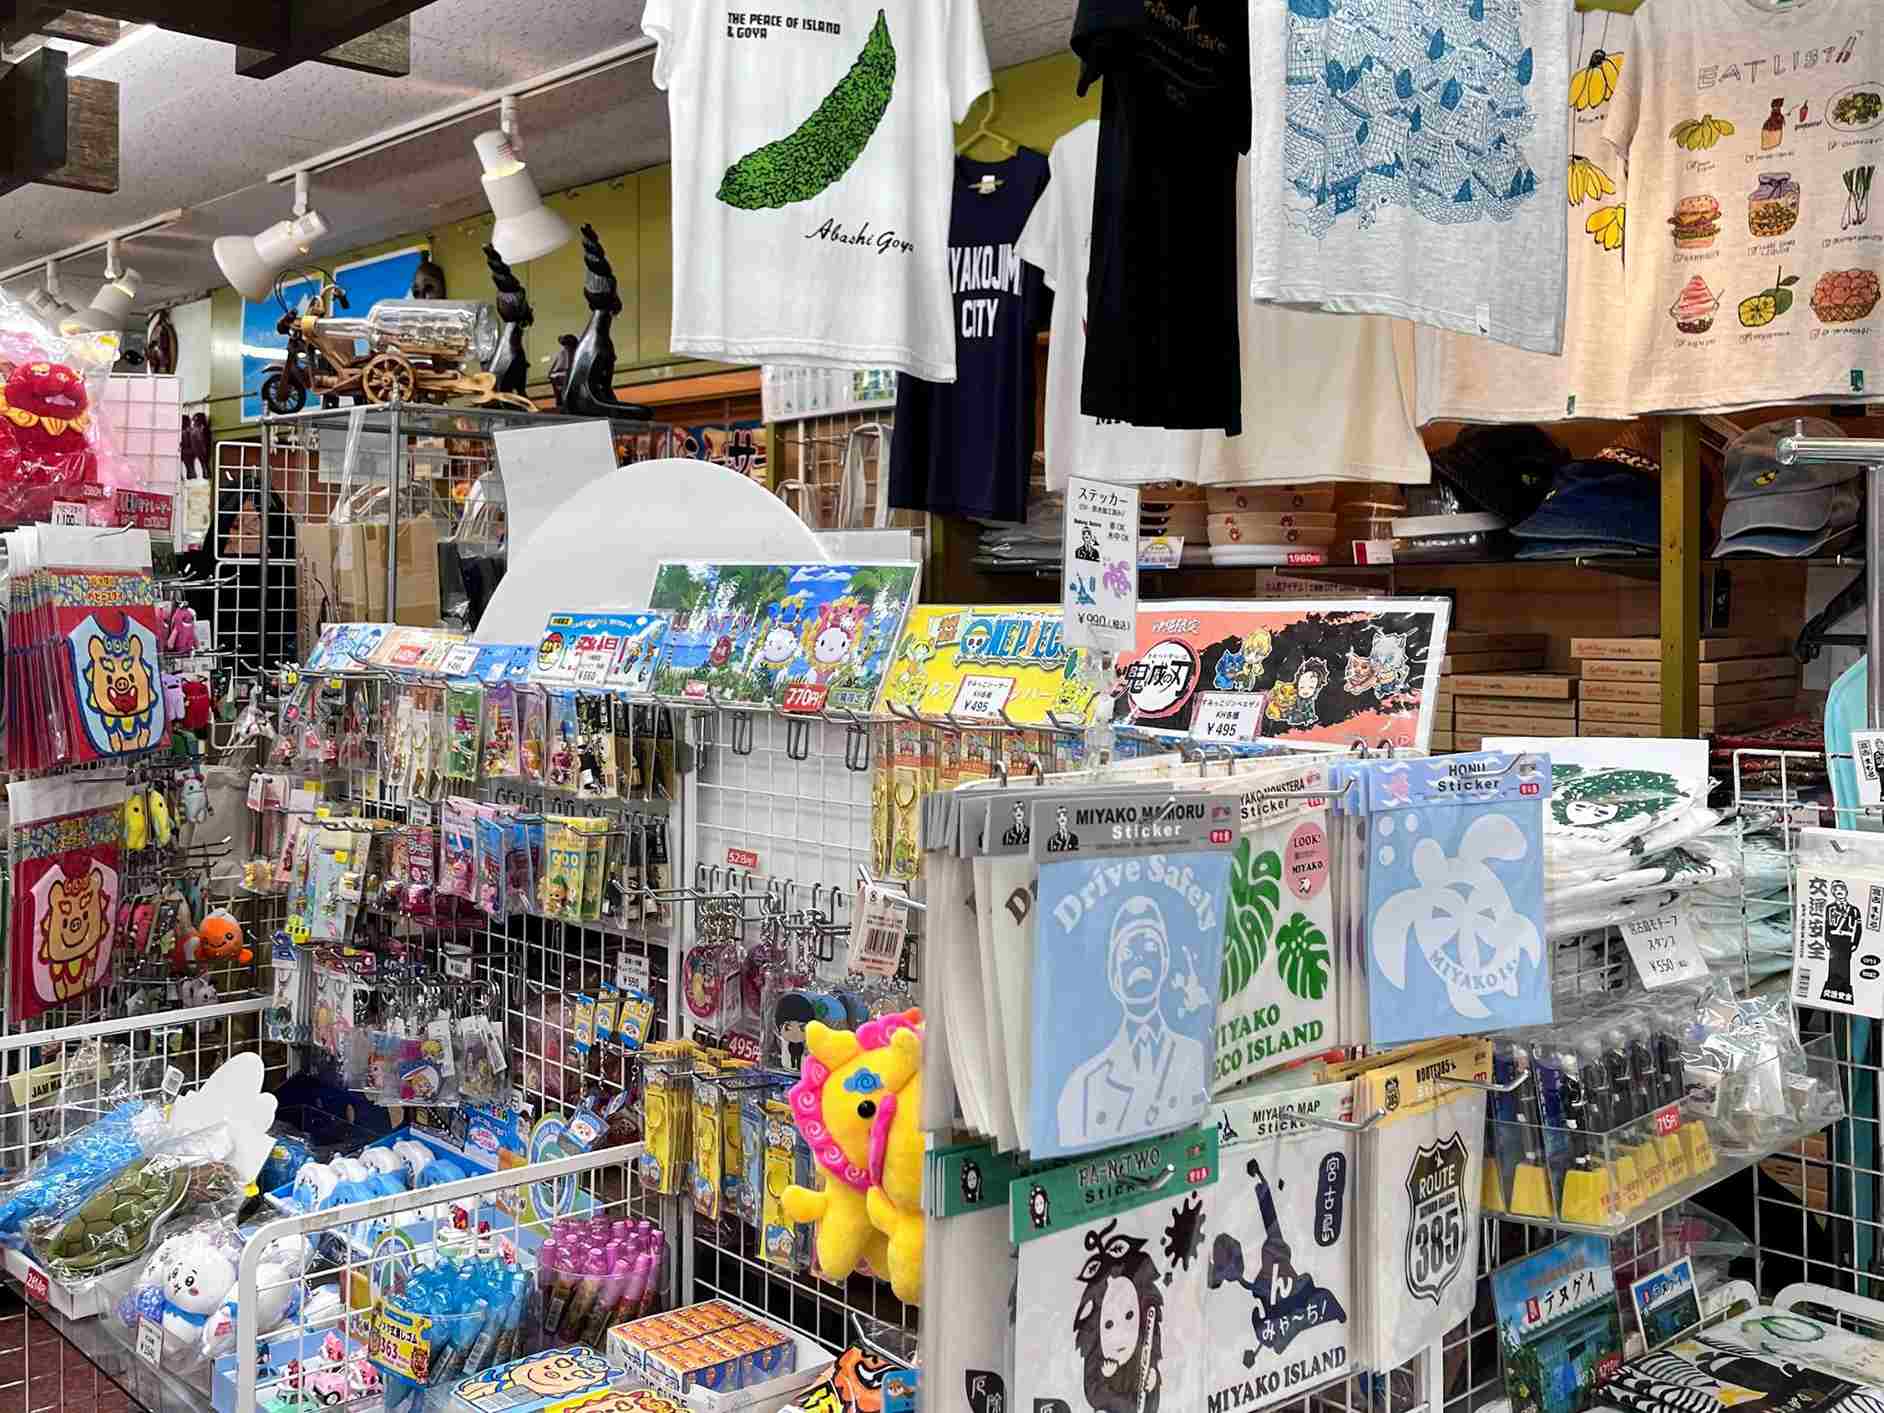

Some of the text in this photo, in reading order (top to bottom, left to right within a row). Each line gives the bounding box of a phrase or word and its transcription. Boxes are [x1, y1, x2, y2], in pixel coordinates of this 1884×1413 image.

[727, 26, 767, 39] & GOYA
[728, 12, 841, 35] THE PEACE OF ISLAND
[806, 217, 873, 246] Abashi
[948, 243, 1022, 296] YAKOJIM
[961, 297, 999, 339] CITY
[1078, 487, 1128, 506] ステッカー
[962, 617, 1065, 657] ONE PIEC
[1125, 660, 1193, 697] 鬼滅の刃
[1206, 722, 1238, 737] ¥495
[1438, 780, 1499, 793] Sticker
[1076, 807, 1137, 825] MIYAKO
[1241, 801, 1288, 820] Sticker
[1112, 824, 1182, 840] Sticker
[1294, 834, 1321, 848] LOOK!
[1292, 861, 1324, 875] MIYAKO
[1052, 853, 1218, 934] Drive Safely
[1808, 876, 1828, 960] 交通安全
[1214, 1003, 1281, 1050] IYAKO
[1247, 1019, 1324, 1065] ISLAND
[1297, 1100, 1321, 1114] MAP
[1258, 1121, 1312, 1136] Sticke
[1419, 1164, 1456, 1199] ROUTE
[1415, 1208, 1459, 1282] 385
[1544, 1271, 1596, 1313] テヌグイ
[1208, 1346, 1346, 1413] MIYAKO ISLAND
